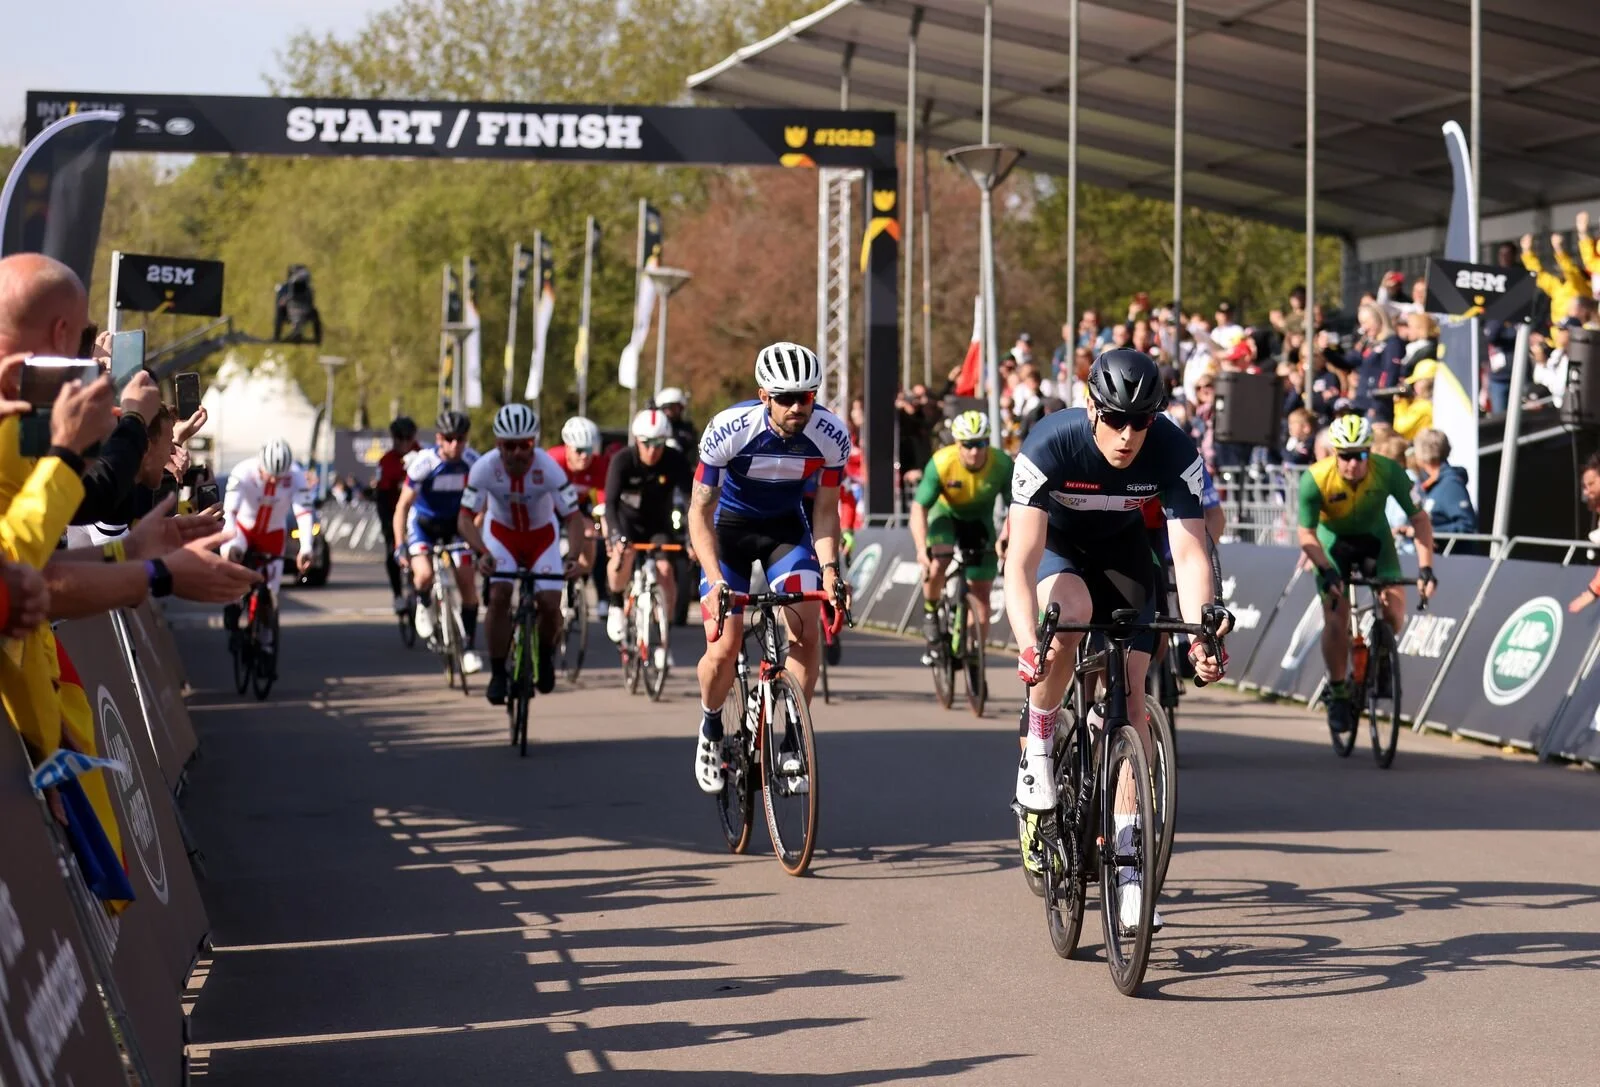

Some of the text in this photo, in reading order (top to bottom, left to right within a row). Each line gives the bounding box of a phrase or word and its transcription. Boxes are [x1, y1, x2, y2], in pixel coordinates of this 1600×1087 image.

[286, 103, 643, 149] START / FINISH
[146, 264, 195, 285] 25M
[1455, 269, 1507, 293] 25M
[703, 413, 750, 458] FRANCE
[1126, 483, 1158, 492] Superdry
